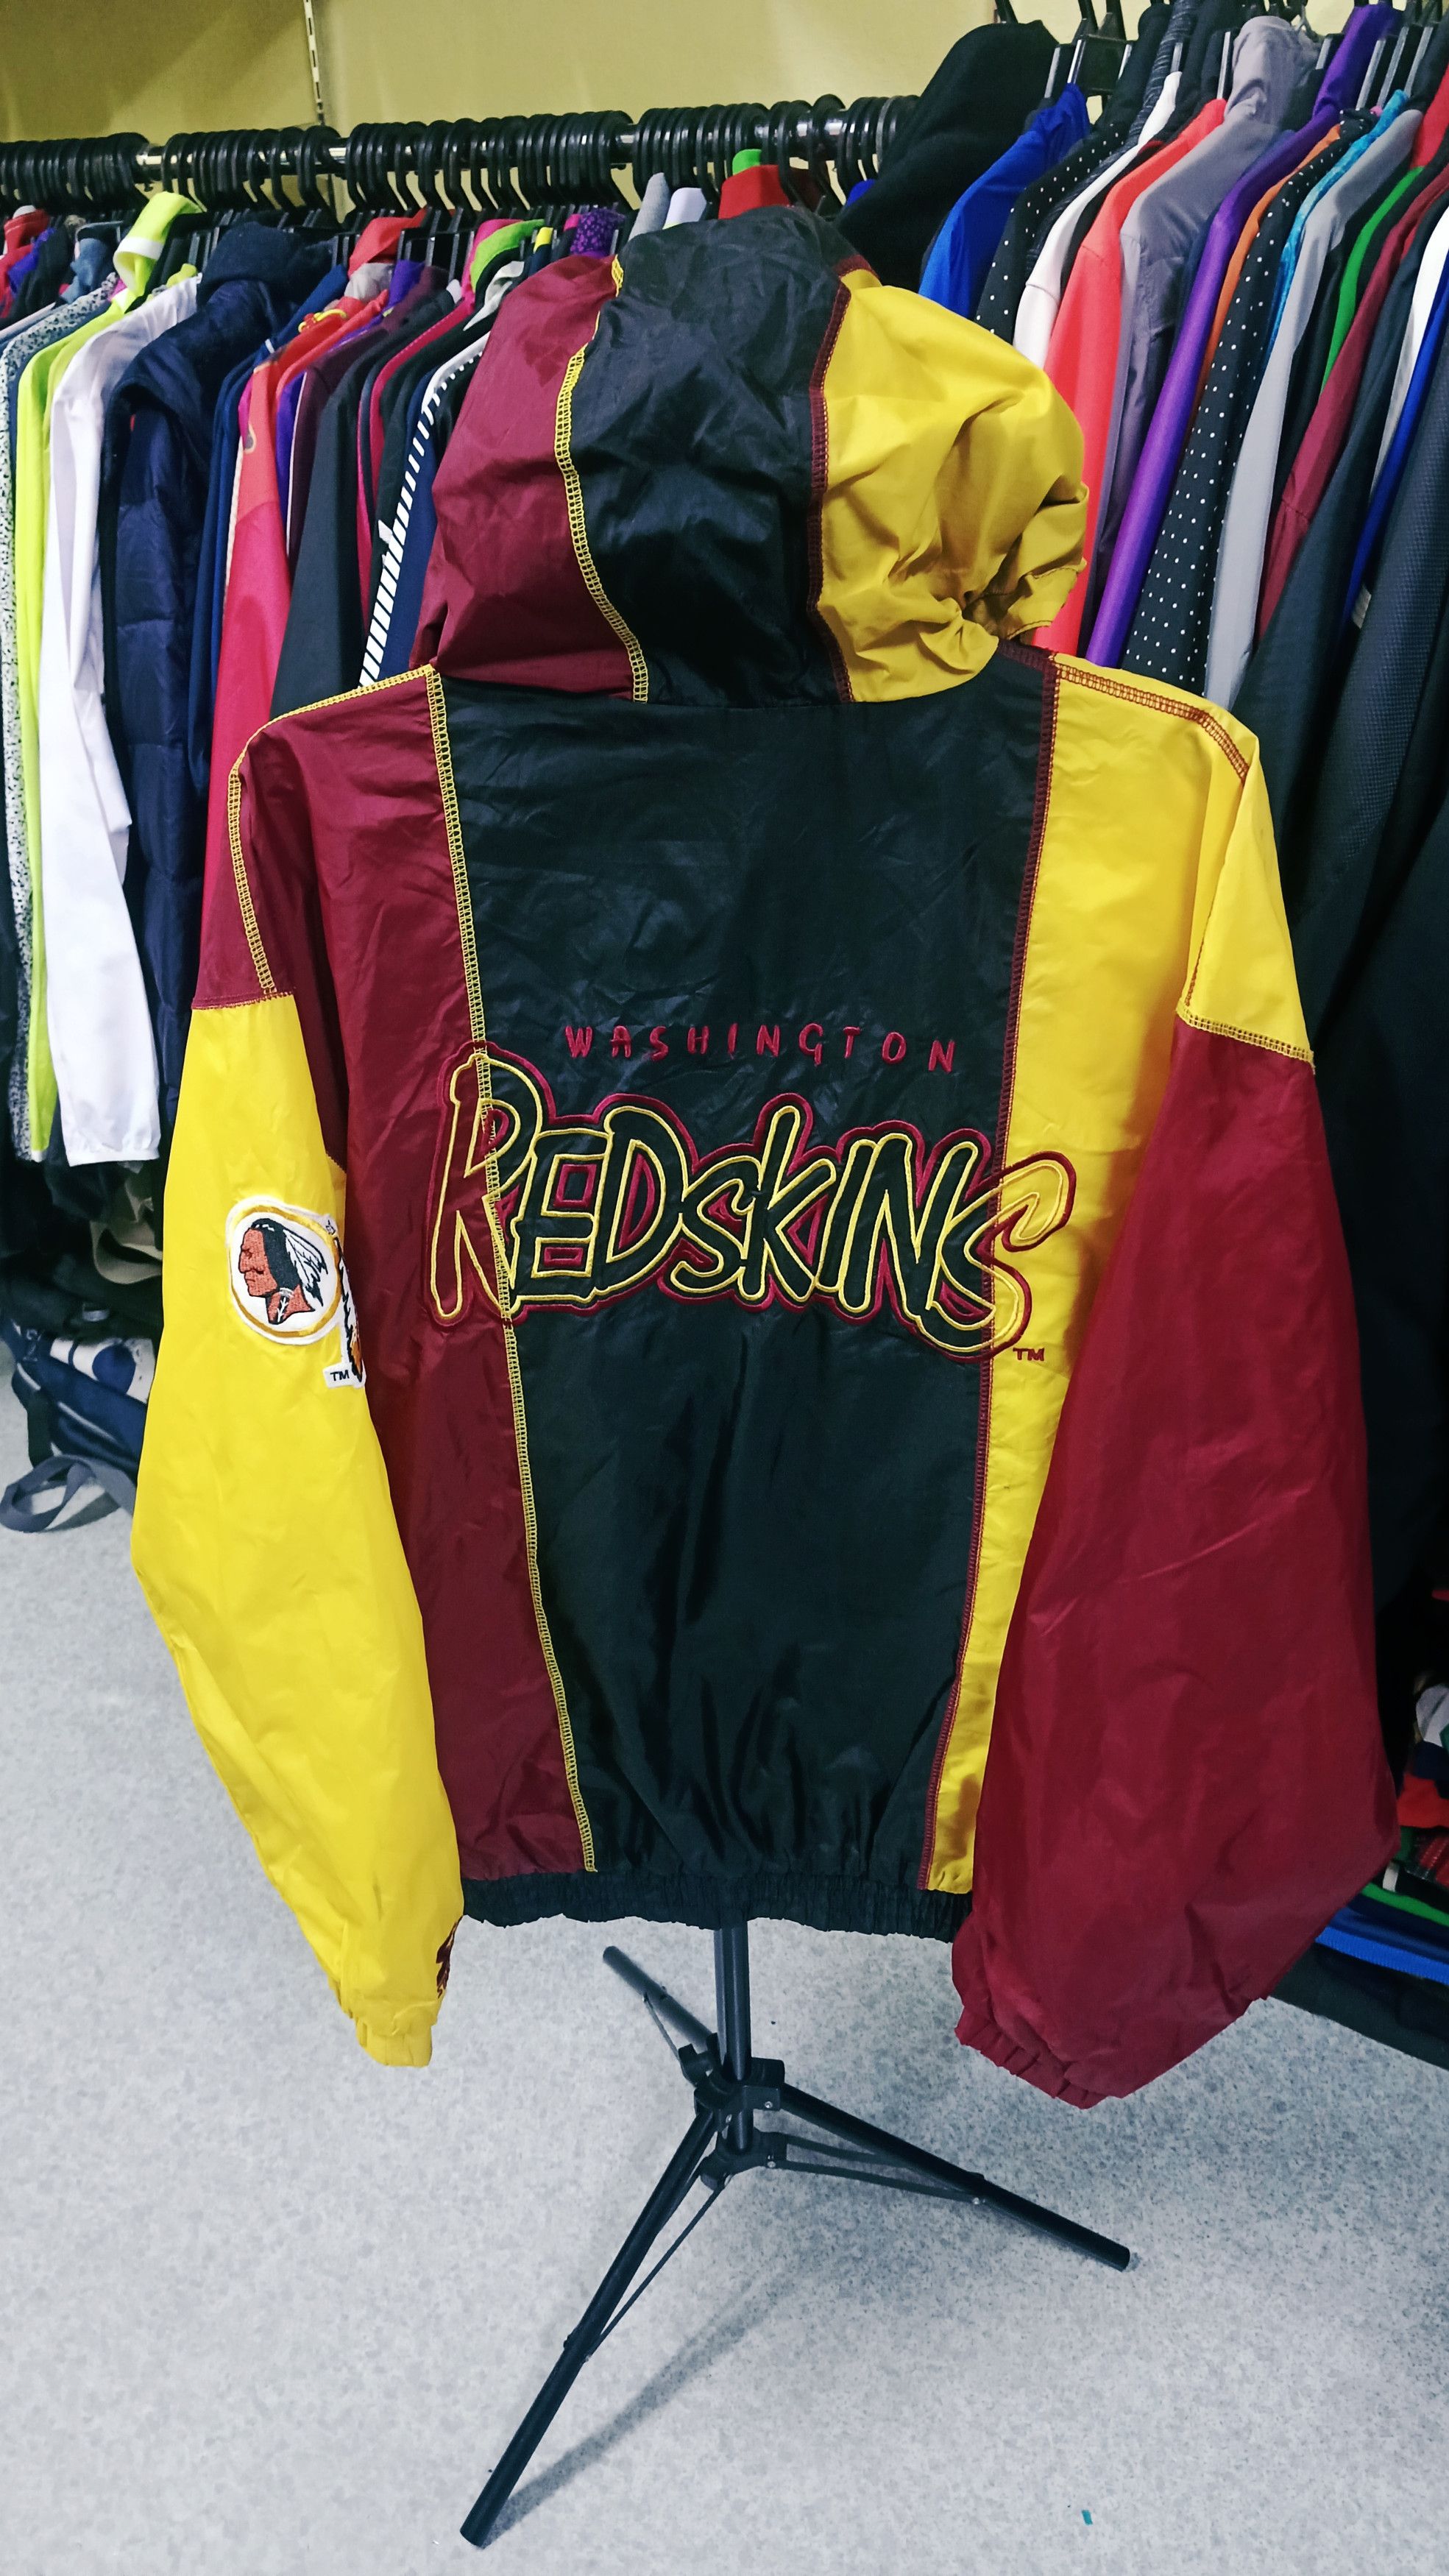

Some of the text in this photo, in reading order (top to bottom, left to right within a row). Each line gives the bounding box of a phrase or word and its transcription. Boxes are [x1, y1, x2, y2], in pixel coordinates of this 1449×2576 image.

[565, 1022, 956, 1074] WASHINGTON
[427, 1042, 1077, 1360] REDSKINS
[1013, 1347, 1045, 1362] TM
[330, 1369, 350, 1381] TM
